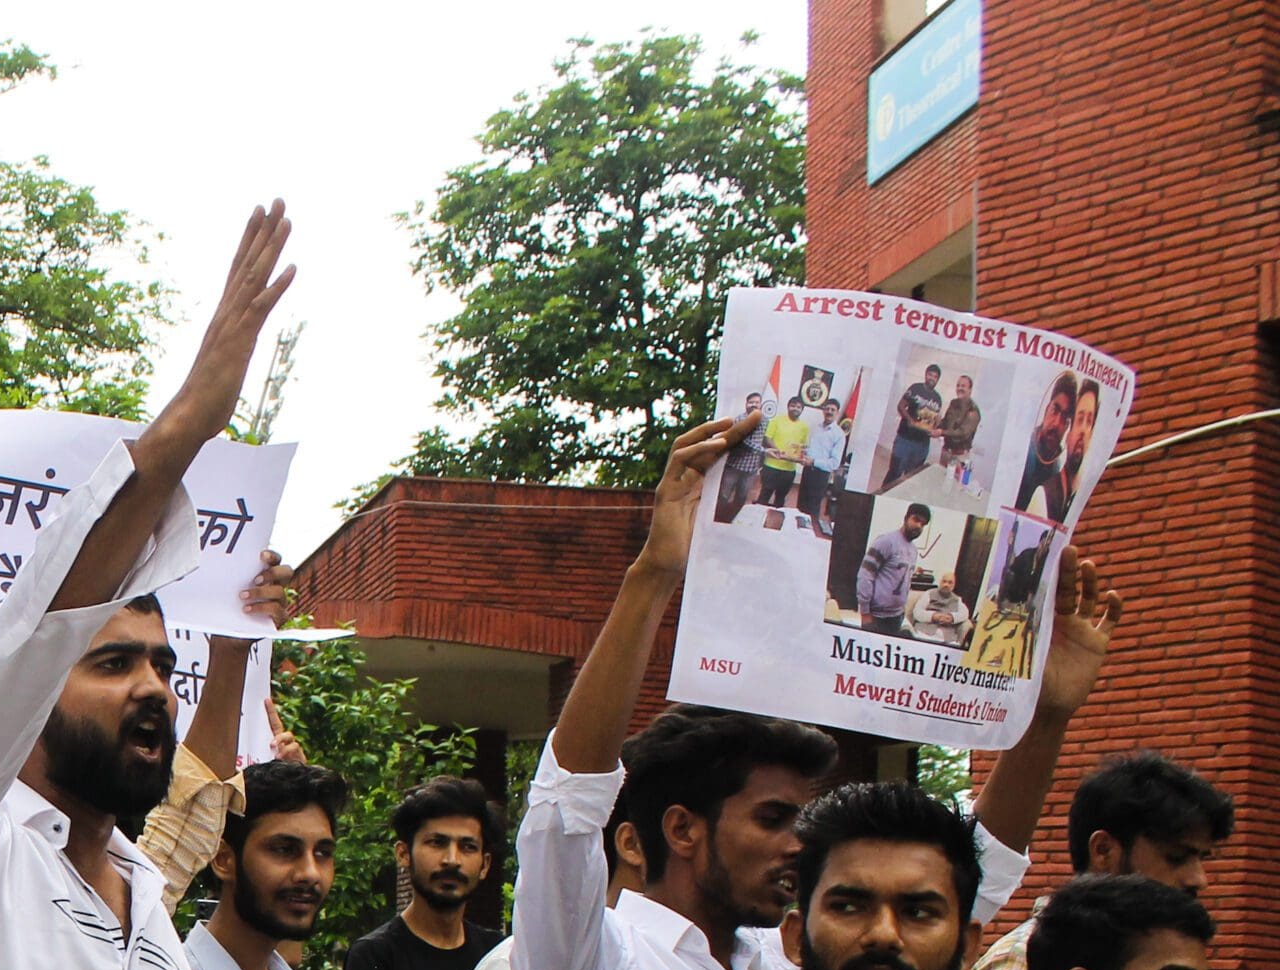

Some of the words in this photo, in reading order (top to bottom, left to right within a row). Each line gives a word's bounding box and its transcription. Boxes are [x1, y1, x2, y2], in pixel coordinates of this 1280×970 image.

[774, 292, 886, 322] Arrest
[894, 303, 1008, 349] terrorist
[1014, 330, 1077, 368] Monu
[699, 656, 742, 675] MSU
[830, 635, 925, 676] Muslim
[930, 652, 971, 685] lives
[833, 673, 913, 708] Mewati
[916, 689, 981, 720] Student's
[981, 701, 1008, 723] Union
